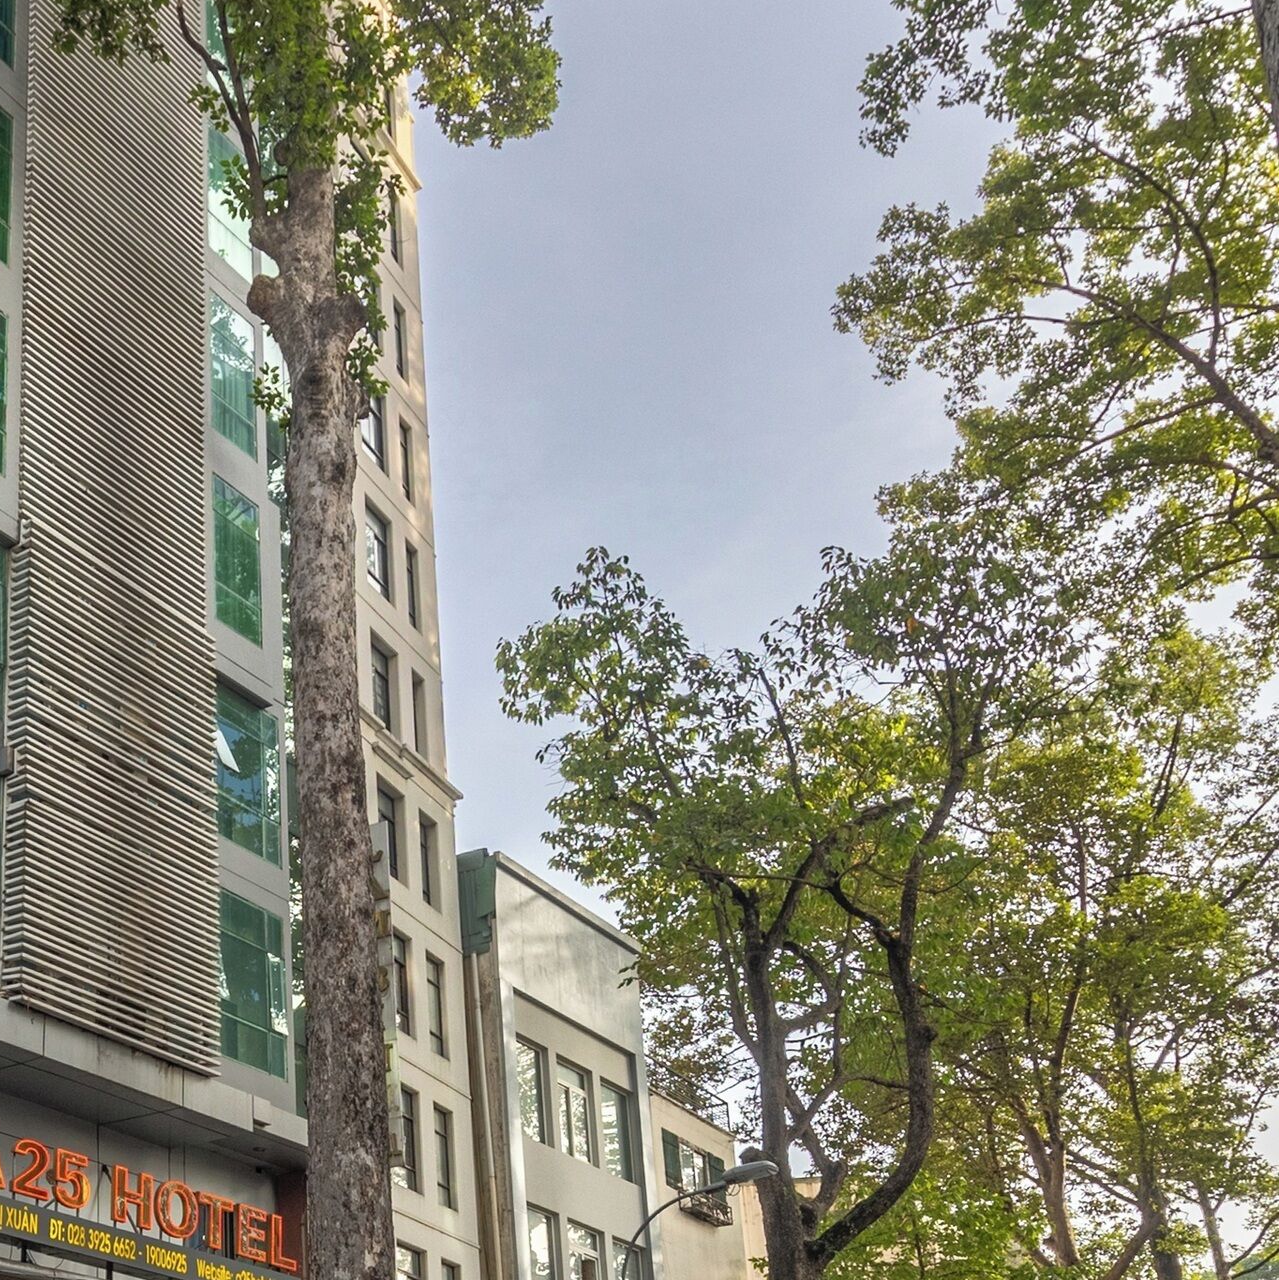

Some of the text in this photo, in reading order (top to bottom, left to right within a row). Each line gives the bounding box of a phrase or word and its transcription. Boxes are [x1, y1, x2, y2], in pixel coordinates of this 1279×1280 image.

[6, 1206, 38, 1235] XUÂN
[49, 1218, 65, 1241] ĐT:
[67, 1223, 86, 1247] 028
[88, 1228, 111, 1254] 3925
[113, 1236, 136, 1260] 6652
[145, 1244, 188, 1274] 19006925
[111, 1163, 297, 1272] HOTEL
